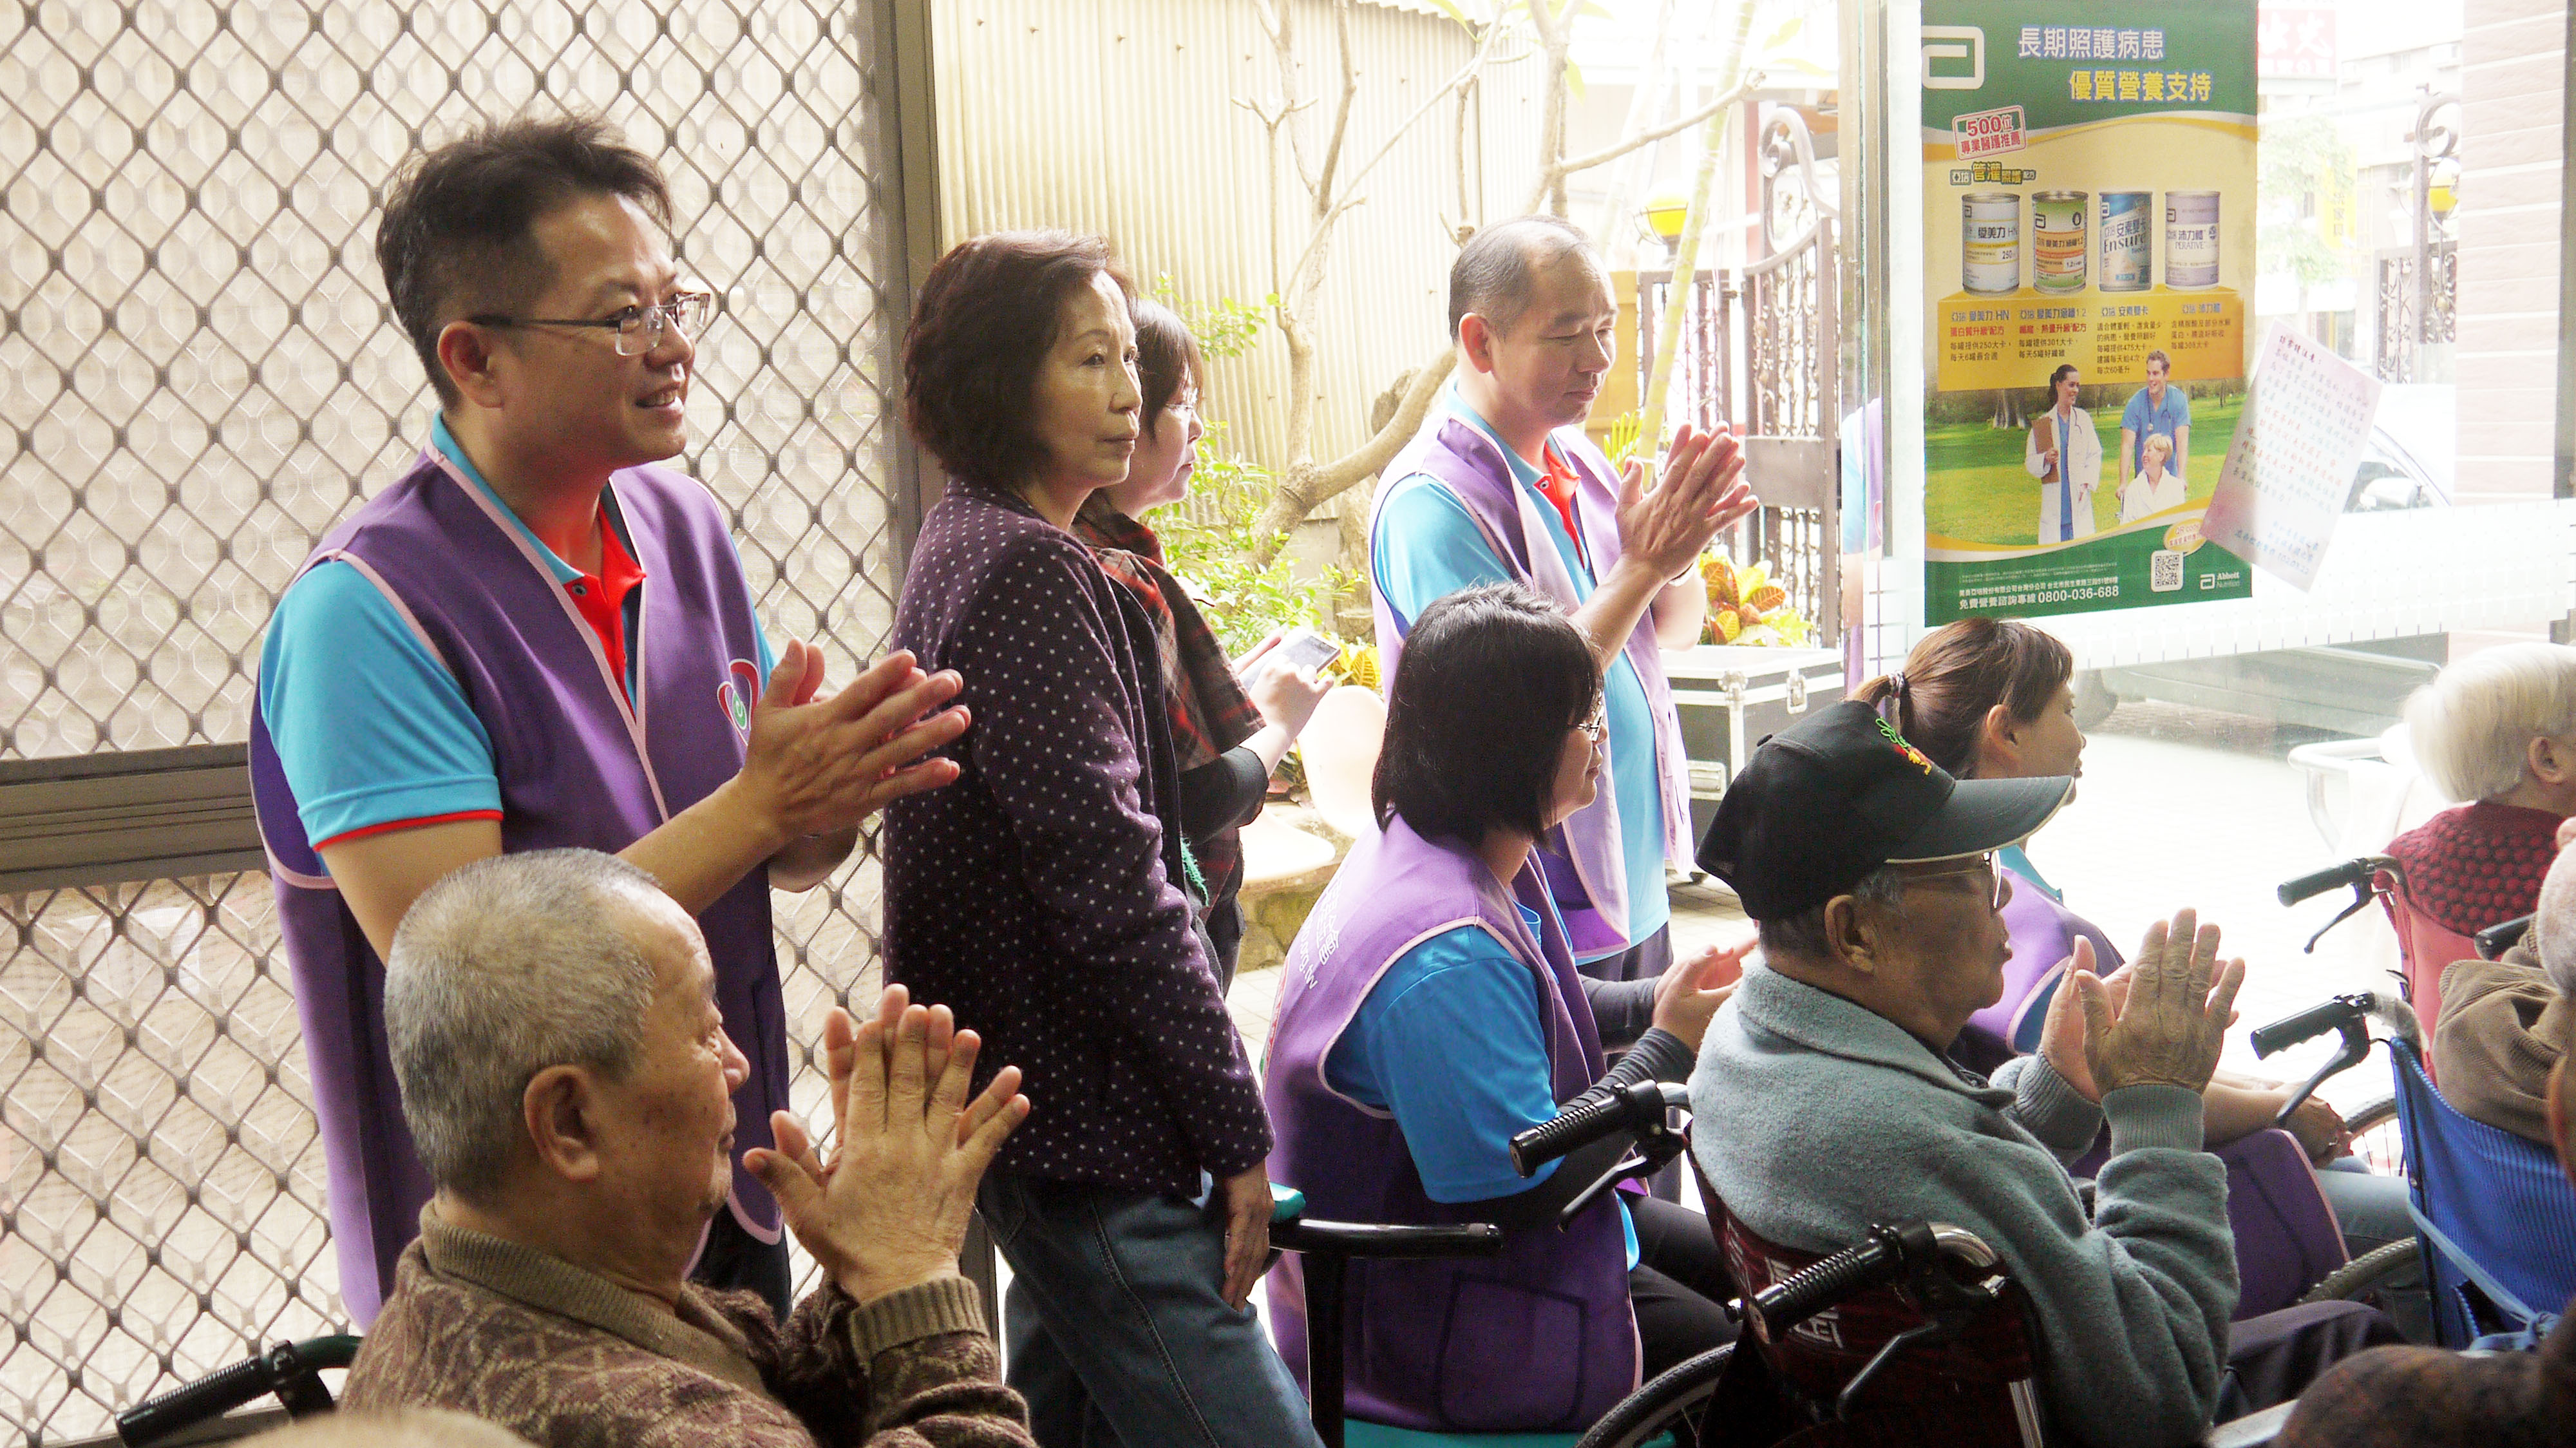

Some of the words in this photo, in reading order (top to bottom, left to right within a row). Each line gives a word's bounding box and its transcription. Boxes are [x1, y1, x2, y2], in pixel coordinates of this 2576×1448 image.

[2018, 27, 2163, 59] 長期照護病患
[2069, 70, 2212, 102] 優質營養支持
[1967, 115, 2013, 137] 500位
[2103, 232, 2146, 254] Ensure
[1996, 309, 2009, 321] HN
[2217, 571, 2240, 581] Abbott
[2038, 584, 2119, 604] 0800-036-688
